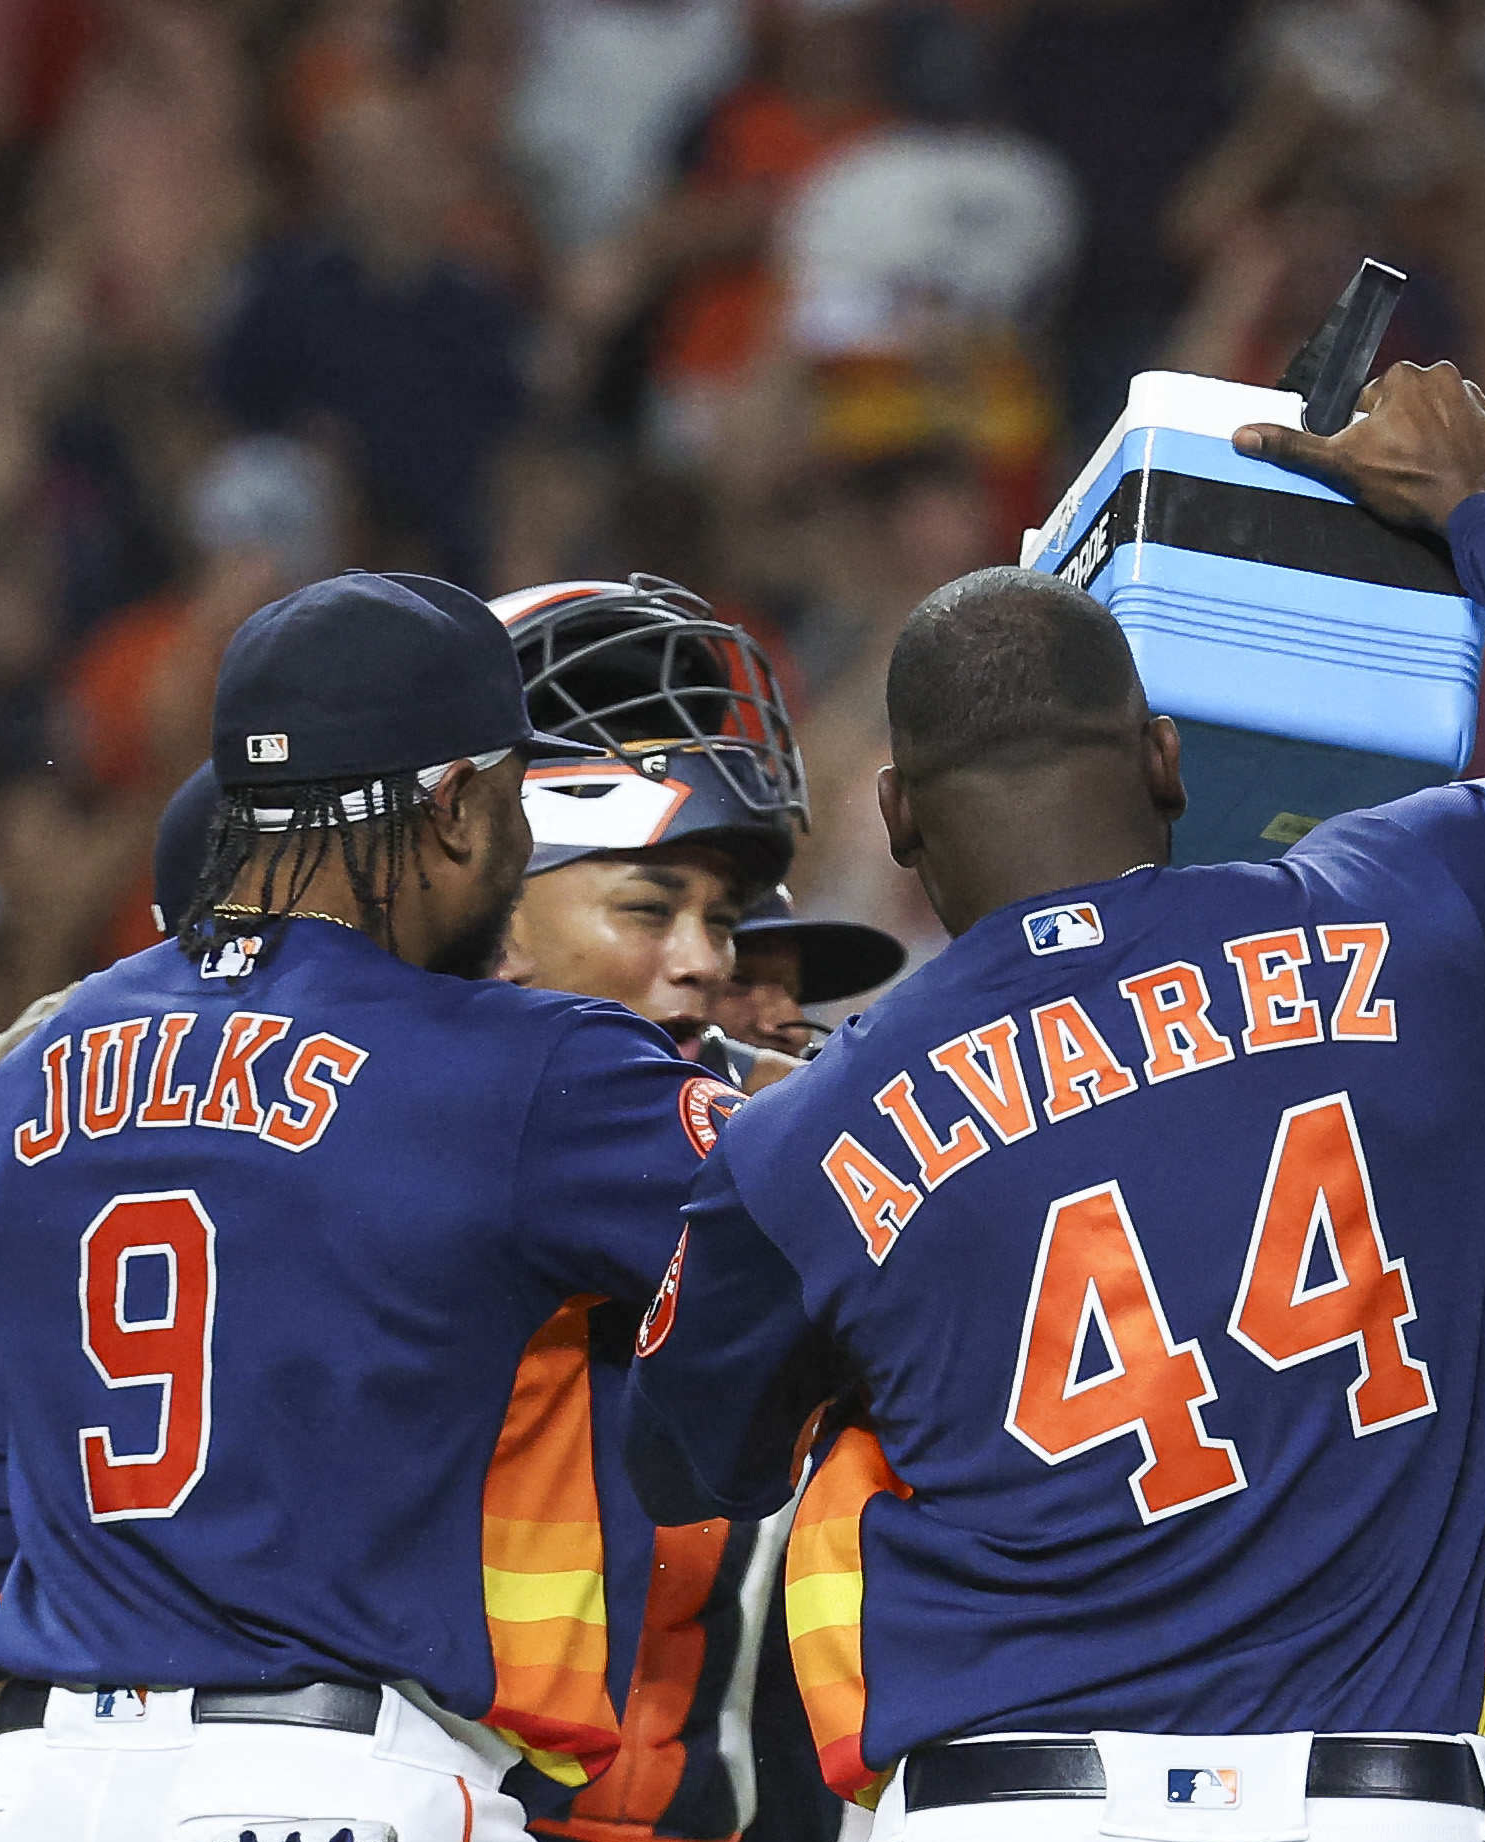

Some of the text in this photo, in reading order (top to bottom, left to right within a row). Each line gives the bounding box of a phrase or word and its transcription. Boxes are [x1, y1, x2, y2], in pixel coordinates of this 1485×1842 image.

[1058, 511, 1110, 589] RADE
[14, 1010, 369, 1166] JULKS
[820, 922, 1397, 1266] ALVAREZ
[78, 1189, 217, 1524] 9
[1004, 1091, 1438, 1525] 44
